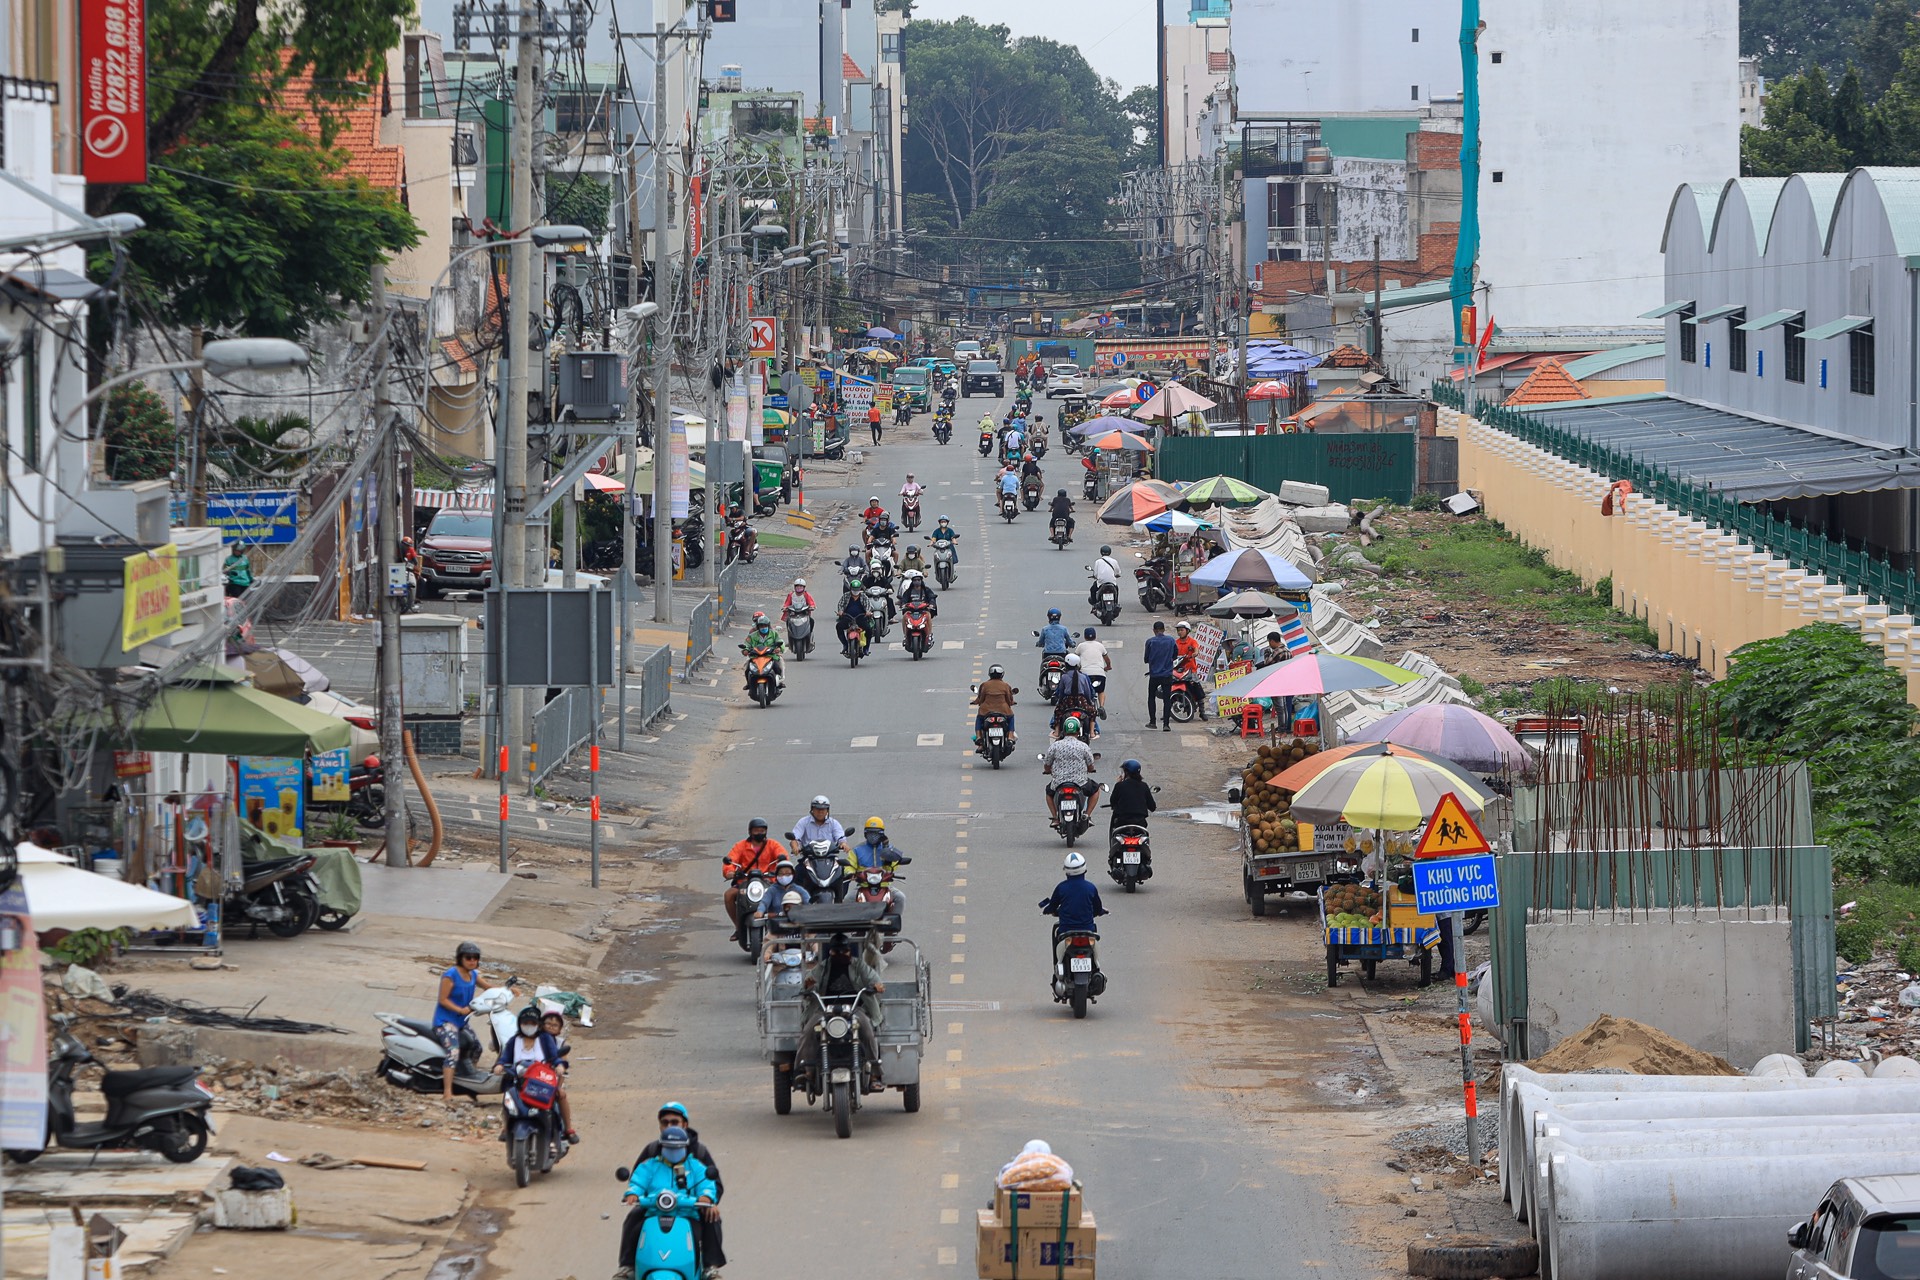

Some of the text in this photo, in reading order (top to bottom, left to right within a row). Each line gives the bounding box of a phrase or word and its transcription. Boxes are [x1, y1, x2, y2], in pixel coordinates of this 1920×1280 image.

[105, 5, 127, 48] 688
[88, 56, 104, 112] Hotline
[105, 48, 128, 115] 02822
[1420, 883, 1495, 907] TRƯỜNG HỌC
[1427, 864, 1482, 886] KHU VỰC
